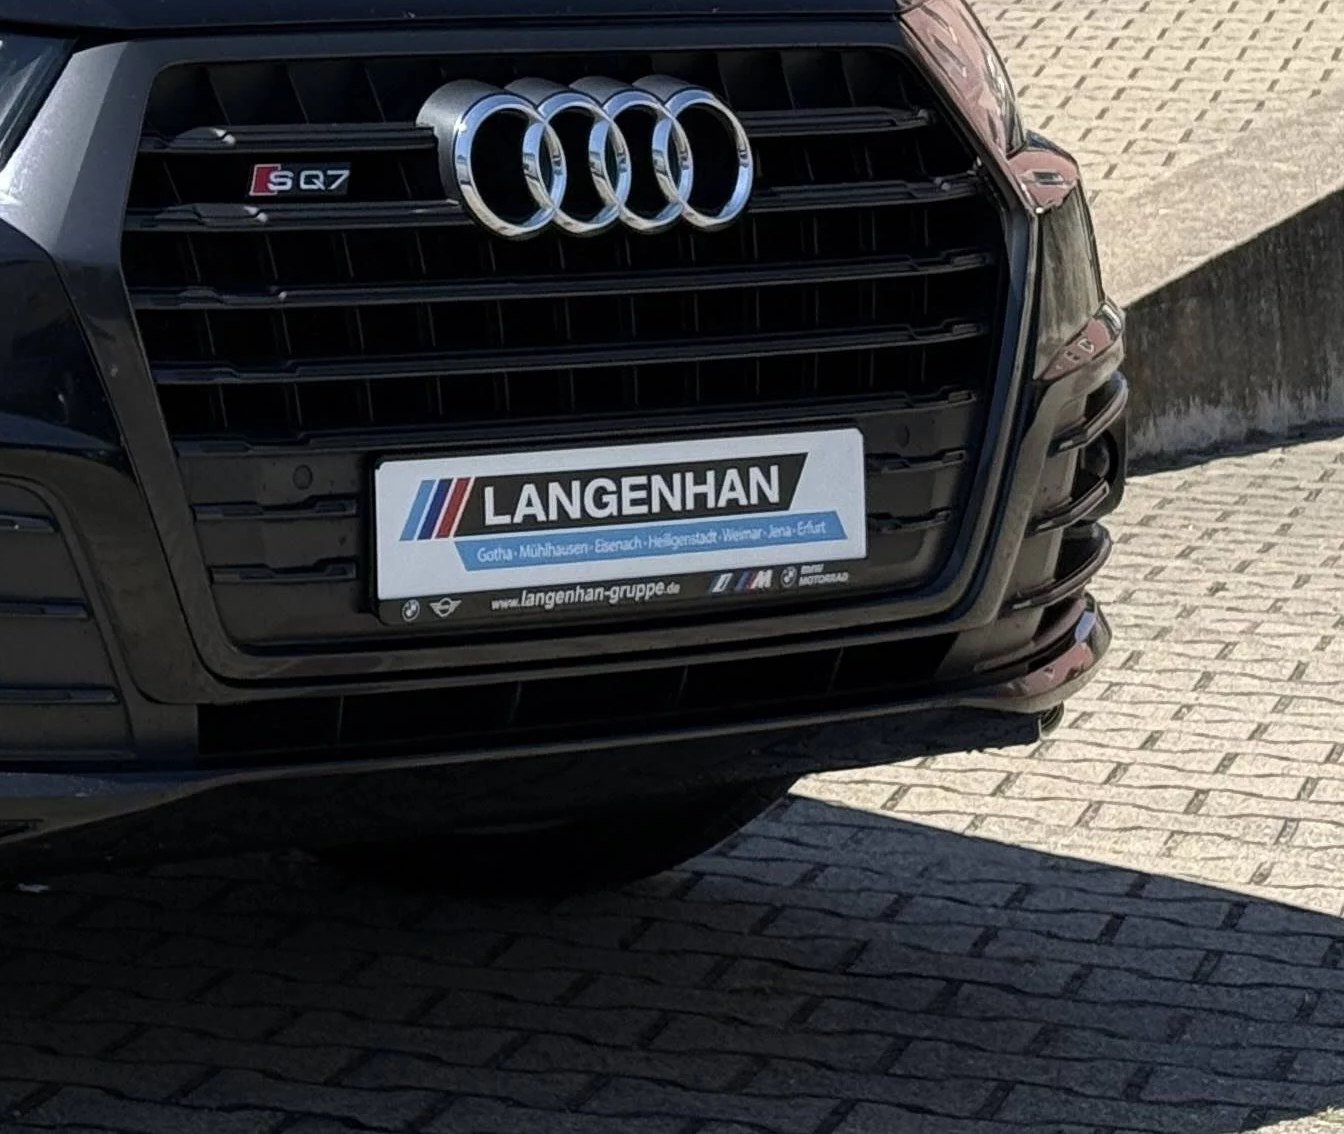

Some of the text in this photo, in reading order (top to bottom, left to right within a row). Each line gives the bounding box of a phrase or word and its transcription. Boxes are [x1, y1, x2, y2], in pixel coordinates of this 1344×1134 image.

[267, 169, 350, 191] SQ7
[483, 465, 781, 527] LANGENHAN
[477, 546, 513, 563] Gotha
[519, 541, 589, 560] Mühlhausen
[595, 536, 642, 553] Eisenach
[723, 525, 763, 542] Weimar
[768, 524, 792, 539] Jena
[797, 520, 827, 535] Erfurt
[491, 581, 681, 610] www.langenhan-gruppe.de
